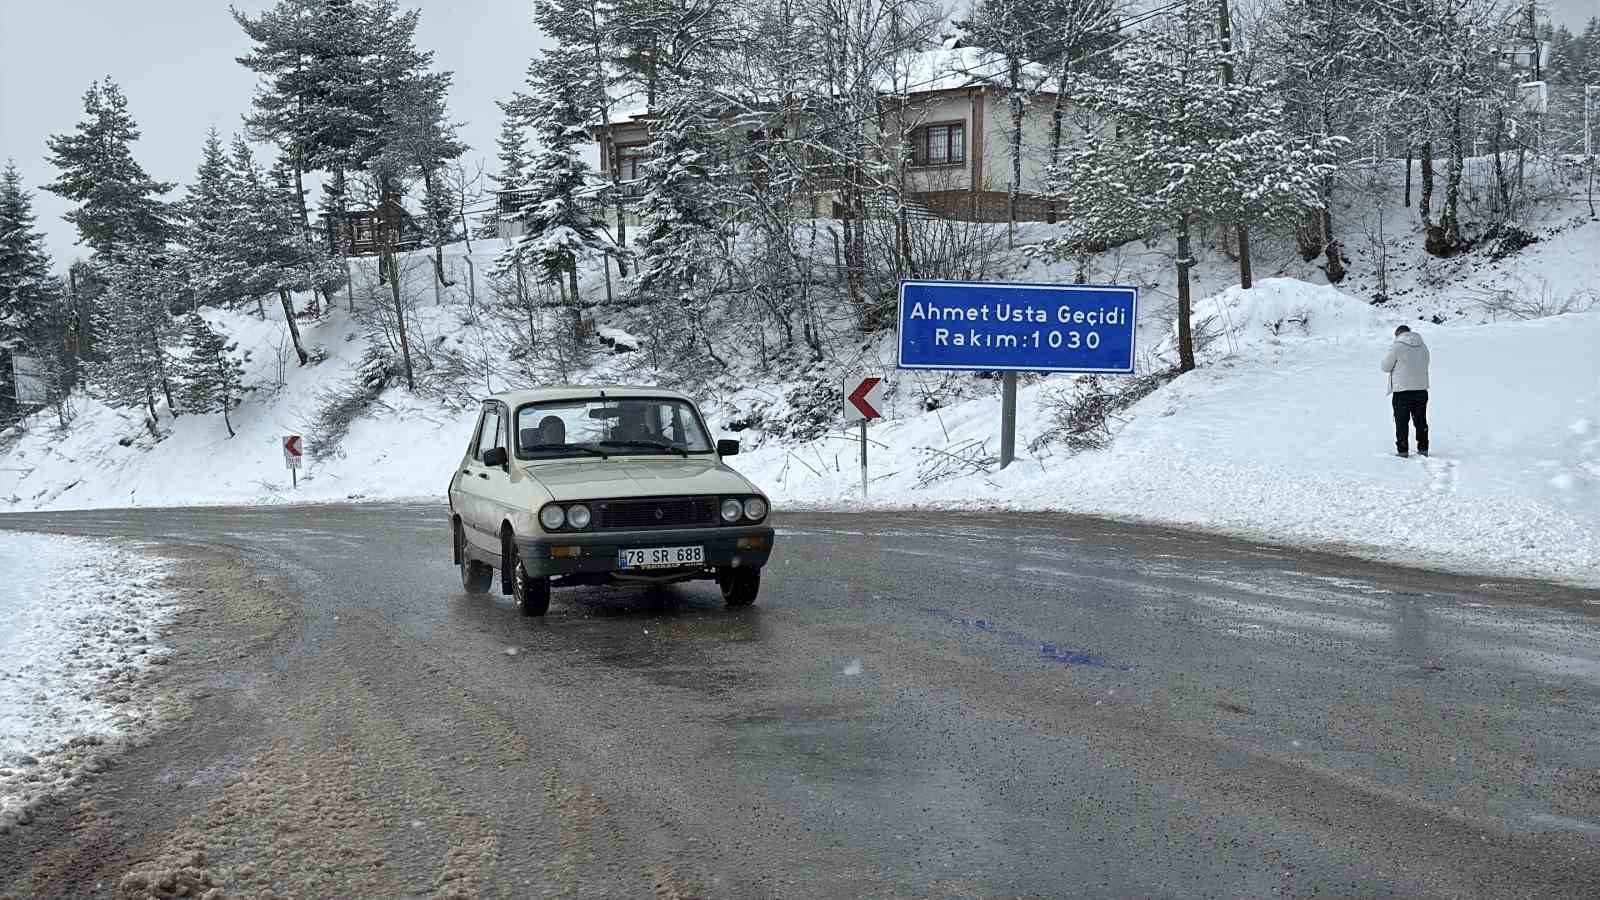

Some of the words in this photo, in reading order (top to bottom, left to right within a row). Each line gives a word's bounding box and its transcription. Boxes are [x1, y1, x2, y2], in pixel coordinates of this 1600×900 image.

[910, 302, 989, 321] Ahmet
[996, 304, 1048, 323] Usta
[1057, 305, 1126, 327] Geçidi
[628, 551, 644, 563] 78
[653, 550, 669, 563] SR
[677, 548, 701, 561] 688
